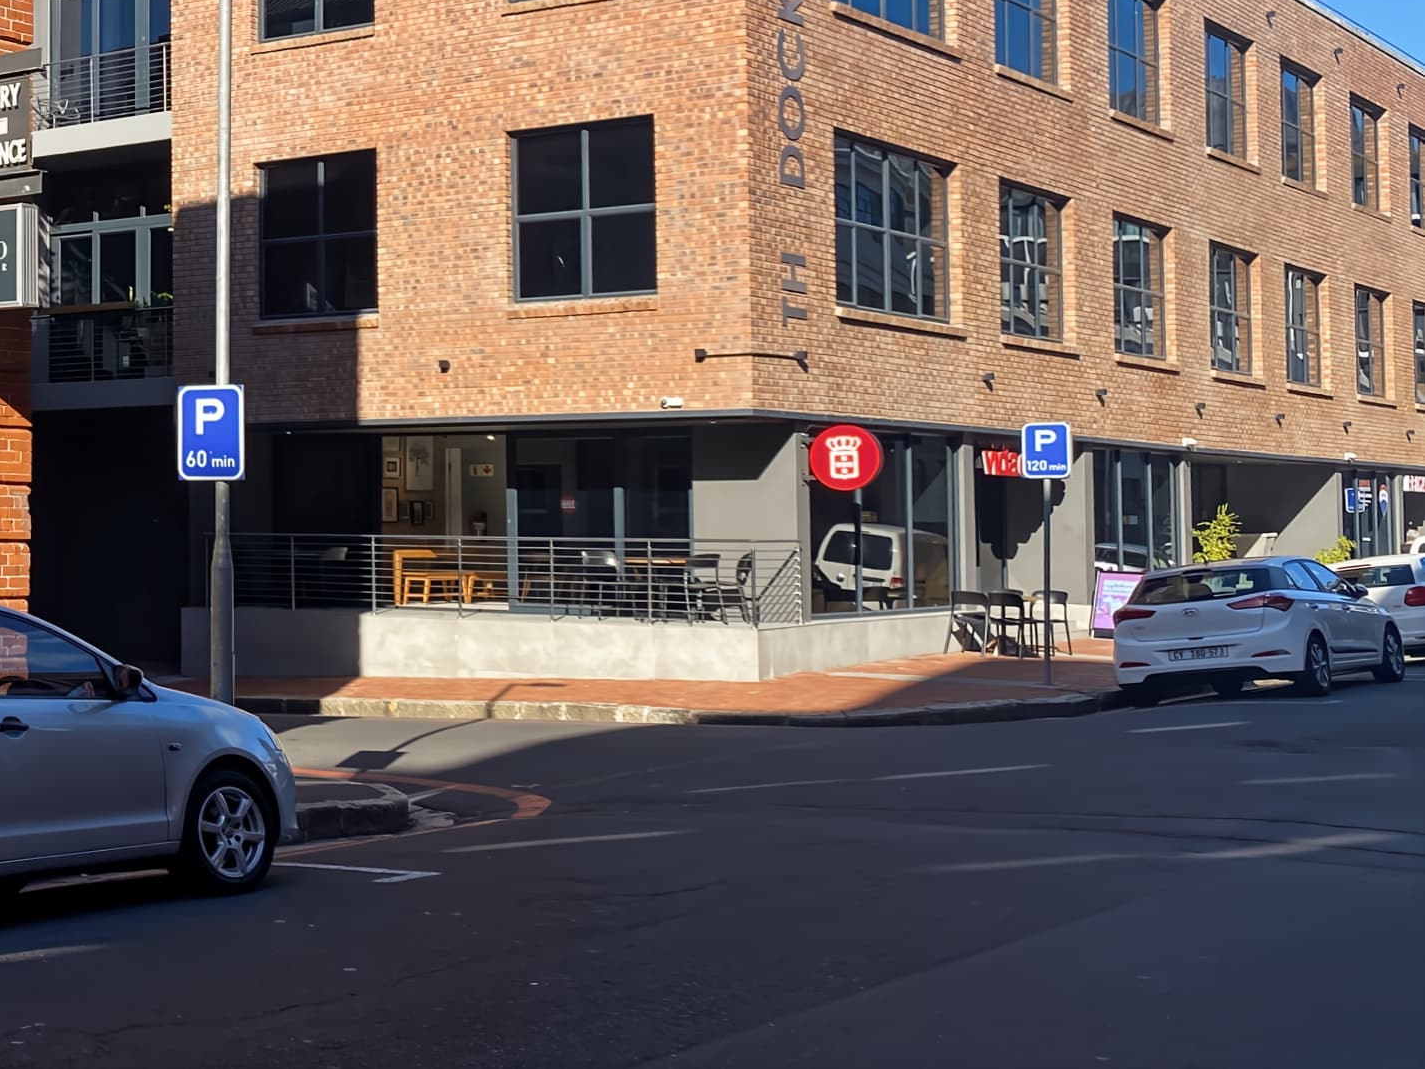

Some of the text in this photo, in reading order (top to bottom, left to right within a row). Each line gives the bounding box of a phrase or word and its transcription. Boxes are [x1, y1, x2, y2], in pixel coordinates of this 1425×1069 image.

[195, 398, 225, 435] P
[1035, 429, 1057, 452] P
[185, 449, 236, 468] 60 min
[1027, 460, 1067, 472] 120 min
